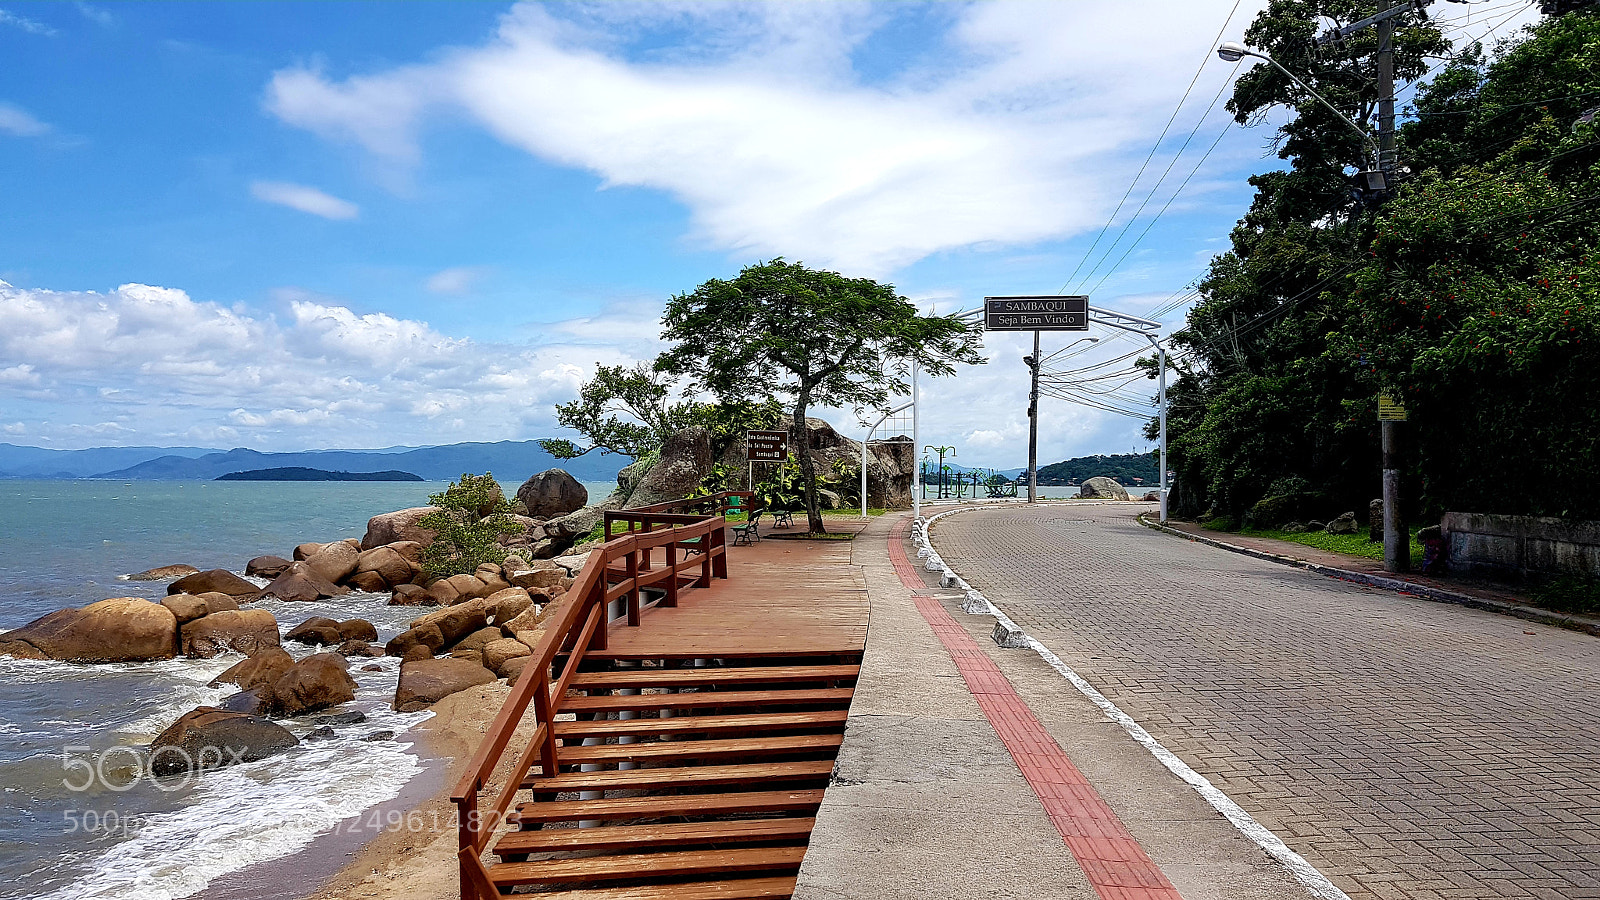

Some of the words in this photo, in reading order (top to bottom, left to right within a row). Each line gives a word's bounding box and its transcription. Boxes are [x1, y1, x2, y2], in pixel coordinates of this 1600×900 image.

[1005, 301, 1067, 312] SAMBAQUI
[998, 315, 1018, 326] Seja
[1020, 315, 1042, 324] Bem
[1044, 314, 1075, 324] Vindo
